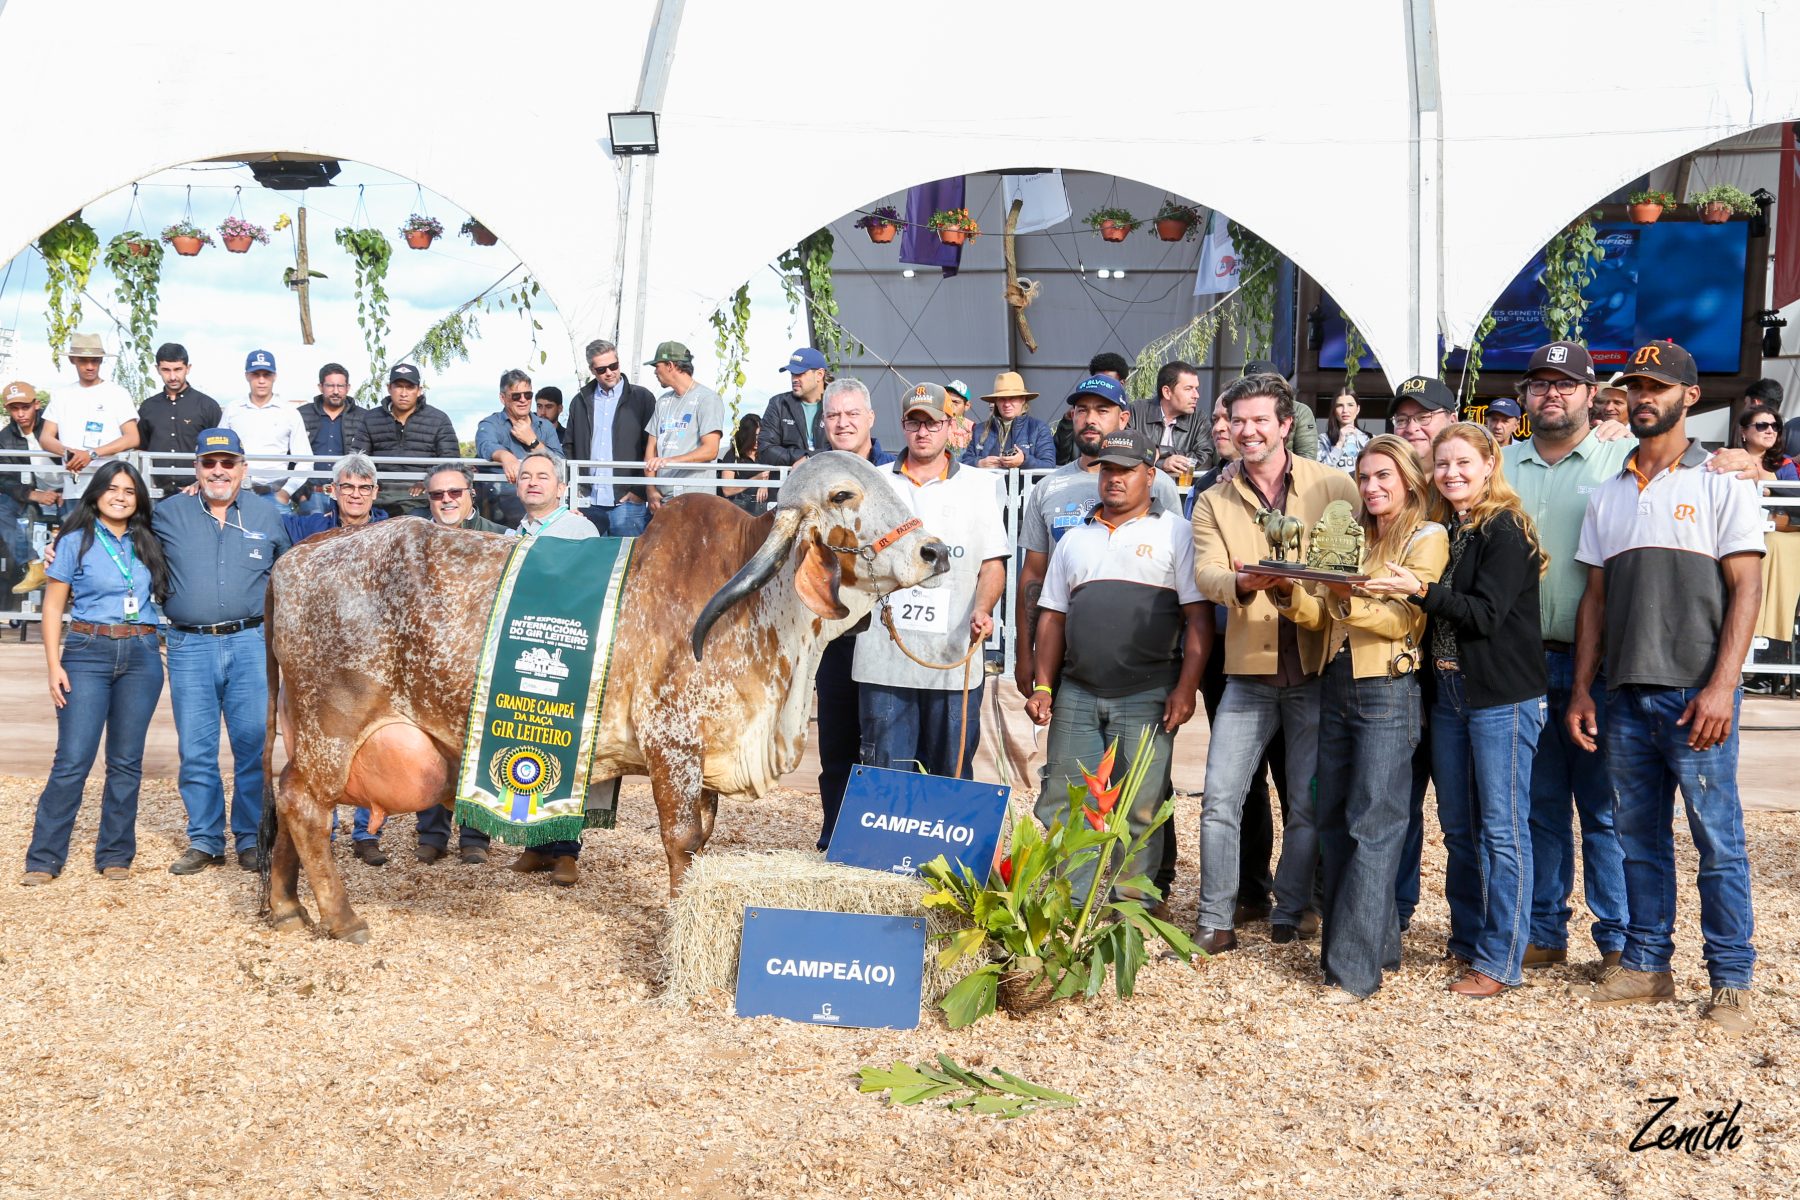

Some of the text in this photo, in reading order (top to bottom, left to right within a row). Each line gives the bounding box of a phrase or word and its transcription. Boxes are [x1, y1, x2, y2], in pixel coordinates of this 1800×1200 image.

[1402, 378, 1427, 391] BOI
[536, 616, 582, 628] EXPOSIÇÃO
[902, 604, 935, 622] 275
[509, 627, 524, 636] DO
[526, 629, 543, 639] GIR
[545, 631, 588, 646] LEITEIRO
[511, 619, 589, 638] INTERNACIONAL
[495, 692, 575, 719] GRANDE CAMPEÃ
[514, 712, 554, 727] DA RAÇA
[491, 719, 573, 748] GIR LEITEIRO
[860, 812, 975, 846] CAMPEÃ(O)
[766, 958, 896, 986] CAMPEÃ(O)
